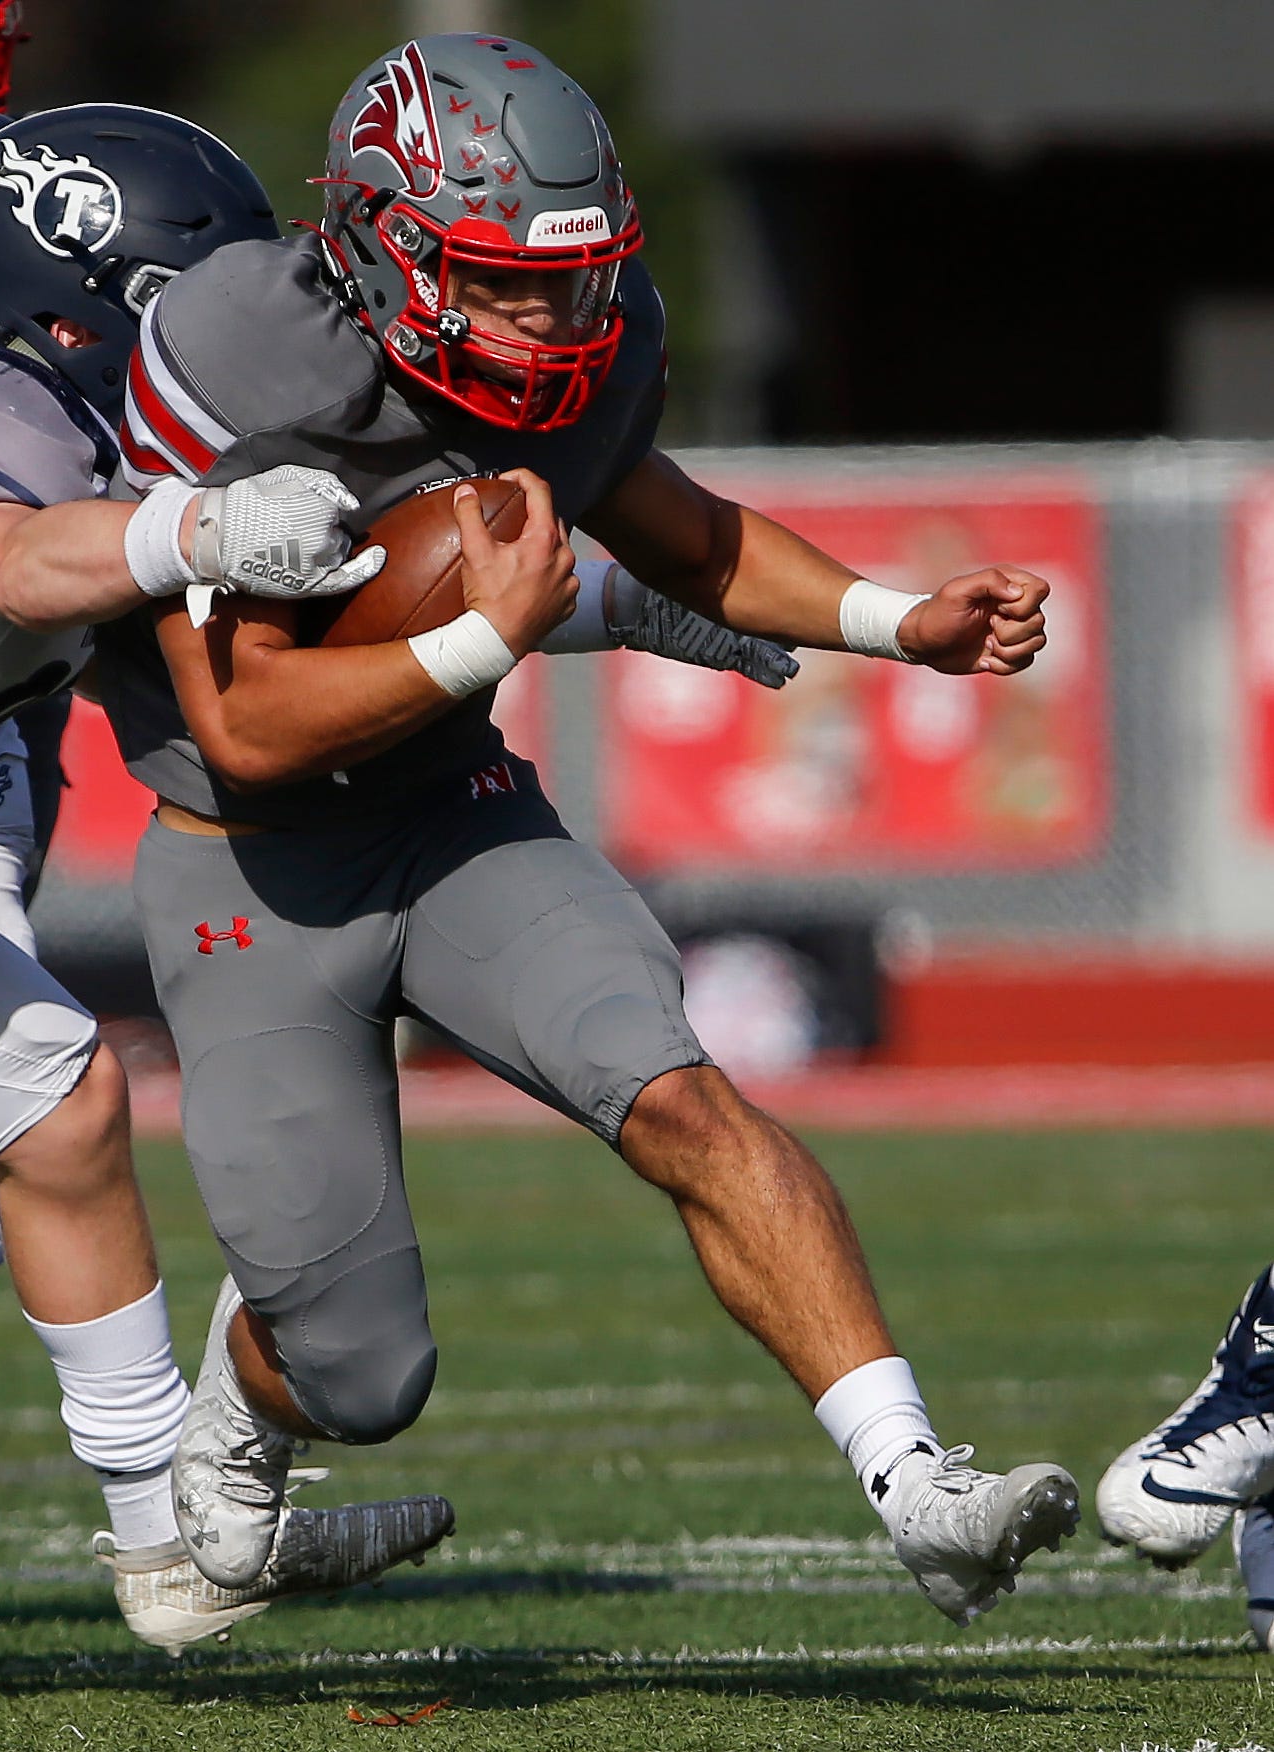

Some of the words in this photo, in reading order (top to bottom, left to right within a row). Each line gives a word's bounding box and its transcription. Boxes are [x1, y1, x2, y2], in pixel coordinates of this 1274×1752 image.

[54, 177, 104, 241] T
[543, 213, 604, 235] Riddell
[241, 559, 306, 590] adidas
